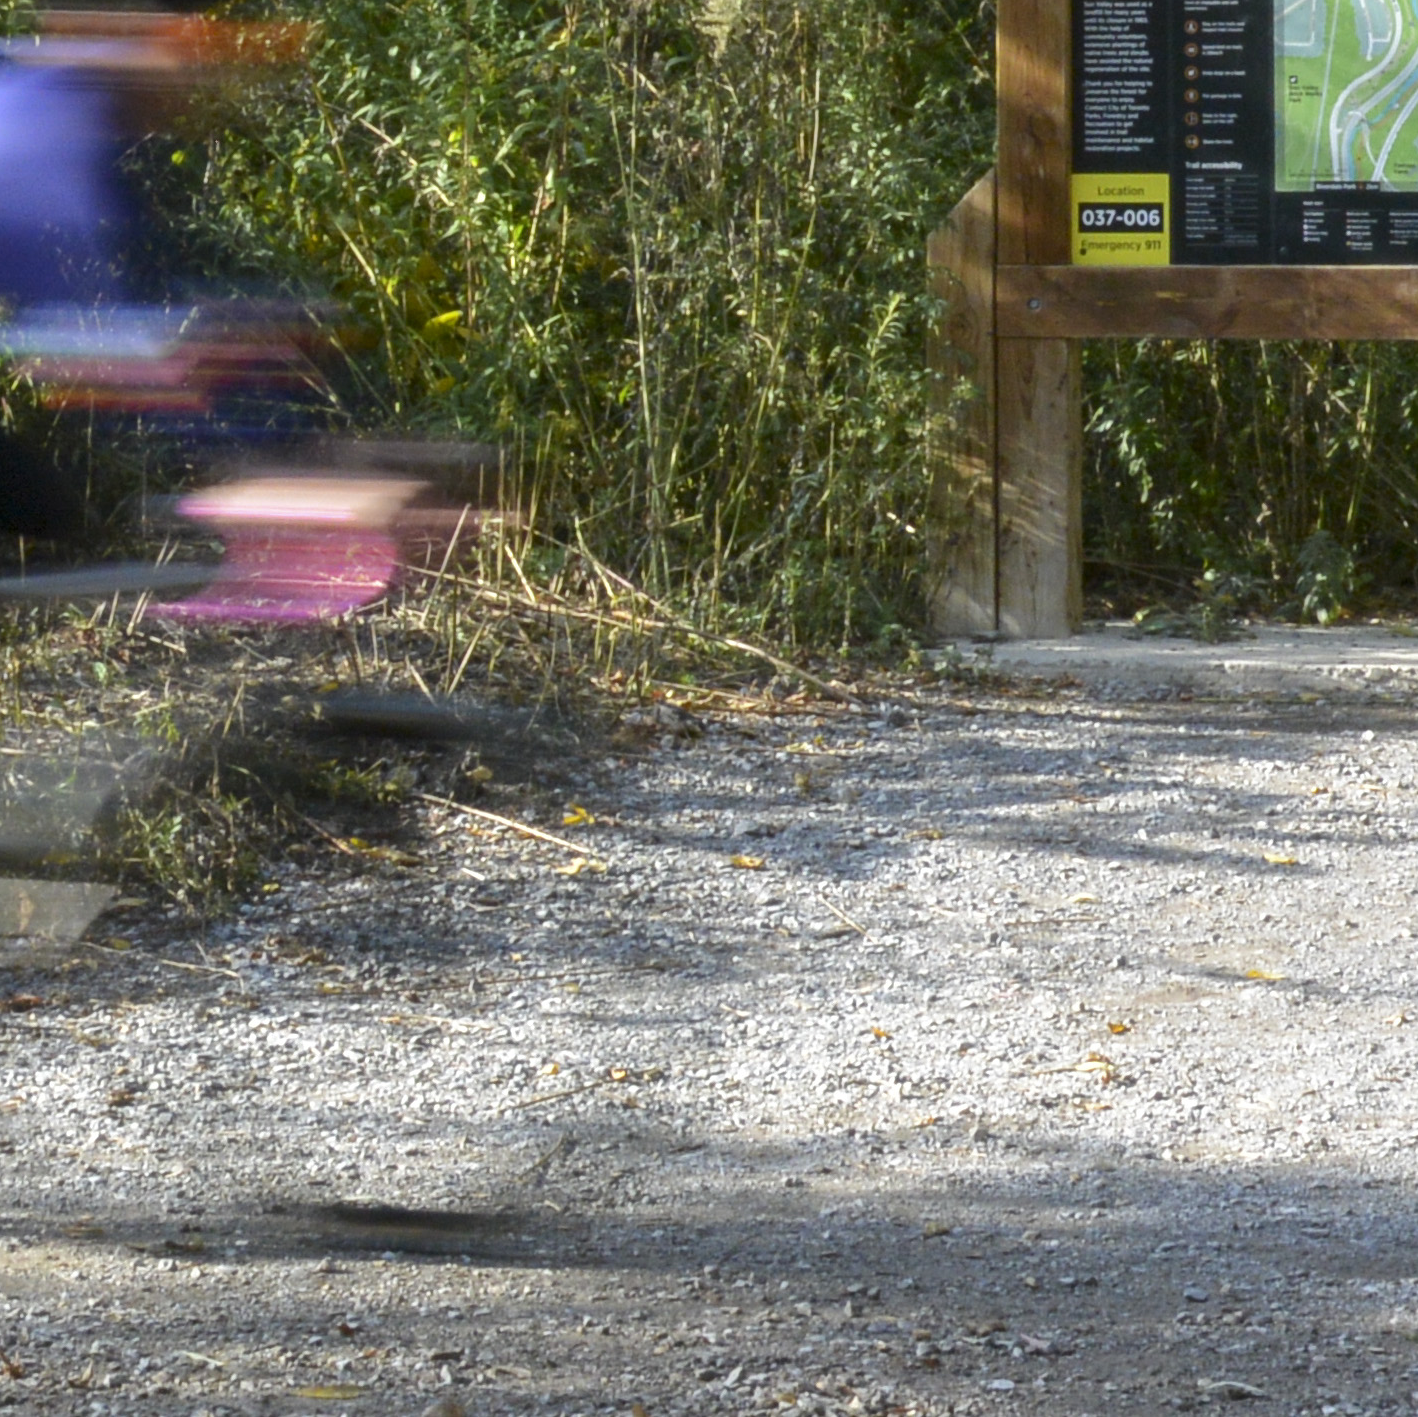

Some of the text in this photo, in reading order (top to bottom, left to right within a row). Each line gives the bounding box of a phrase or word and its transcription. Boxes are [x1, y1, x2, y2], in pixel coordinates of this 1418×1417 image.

[1097, 187, 1144, 195] Location
[1082, 209, 1160, 226] 037-006
[1081, 240, 1161, 251] Emergency 911
